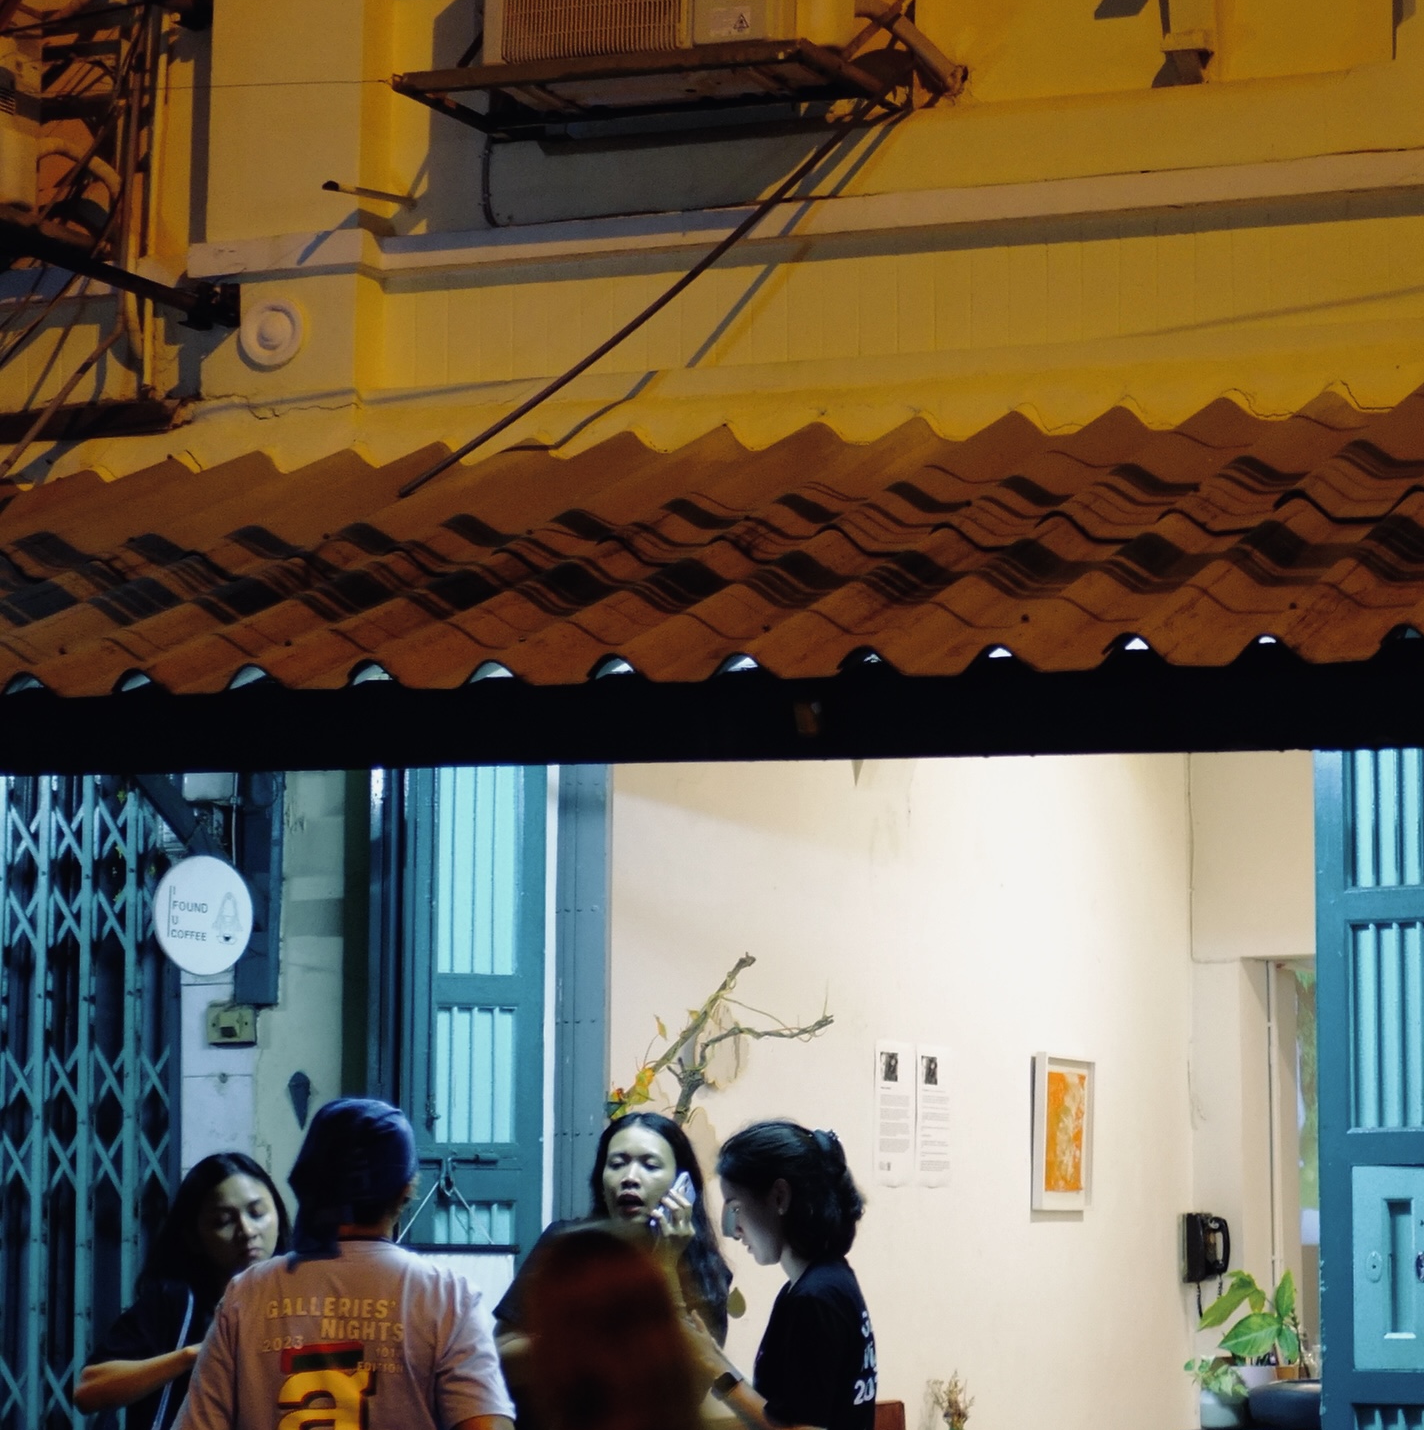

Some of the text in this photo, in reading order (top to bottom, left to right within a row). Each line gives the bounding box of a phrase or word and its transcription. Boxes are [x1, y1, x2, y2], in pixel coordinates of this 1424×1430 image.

[172, 900, 208, 914] FOUND
[171, 915, 179, 925] U
[170, 929, 207, 942] COFFEE
[321, 1318, 405, 1343] NIGHTS
[262, 1335, 304, 1353] 2023
